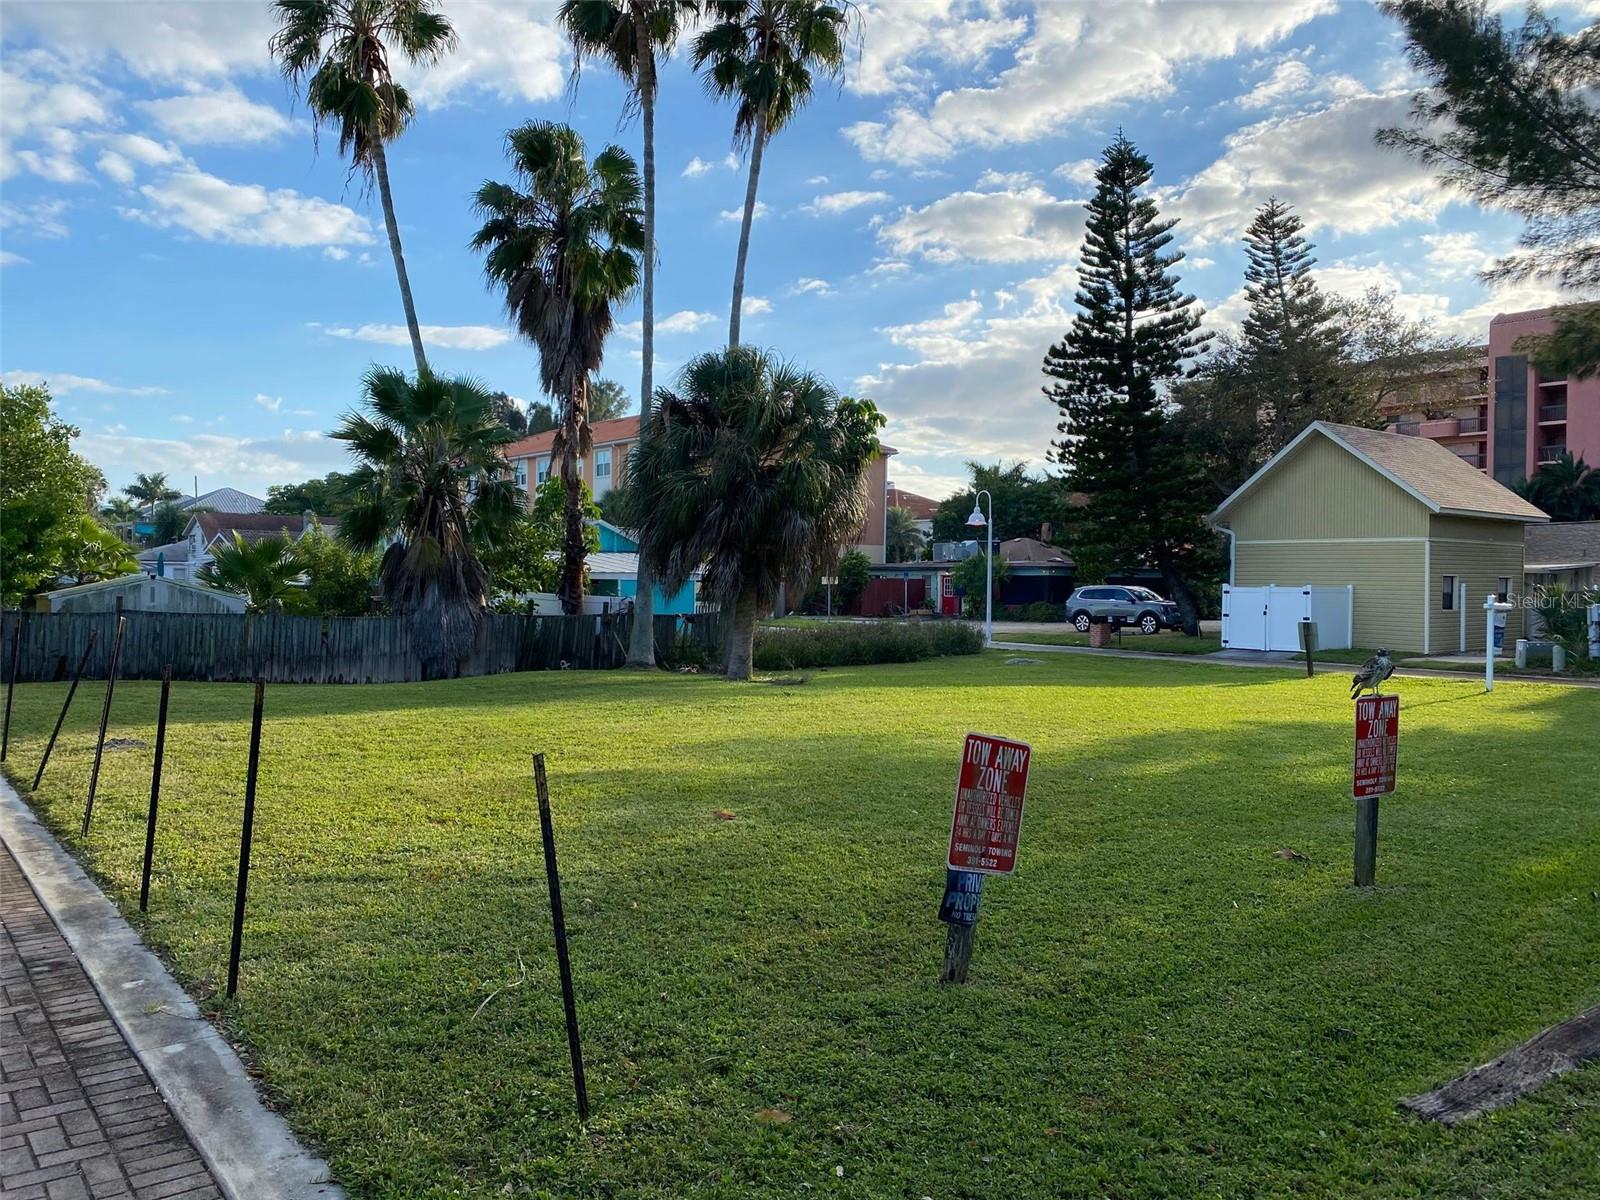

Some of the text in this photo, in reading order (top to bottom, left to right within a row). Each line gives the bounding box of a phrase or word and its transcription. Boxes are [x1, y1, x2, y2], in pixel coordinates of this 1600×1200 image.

[1358, 700, 1397, 720] TOW AWAY
[1368, 719, 1389, 738] ZONE
[968, 739, 1028, 773] TOW AWAY
[976, 766, 1010, 795] ZONE
[955, 843, 1012, 857] SEMINOLE TOWING
